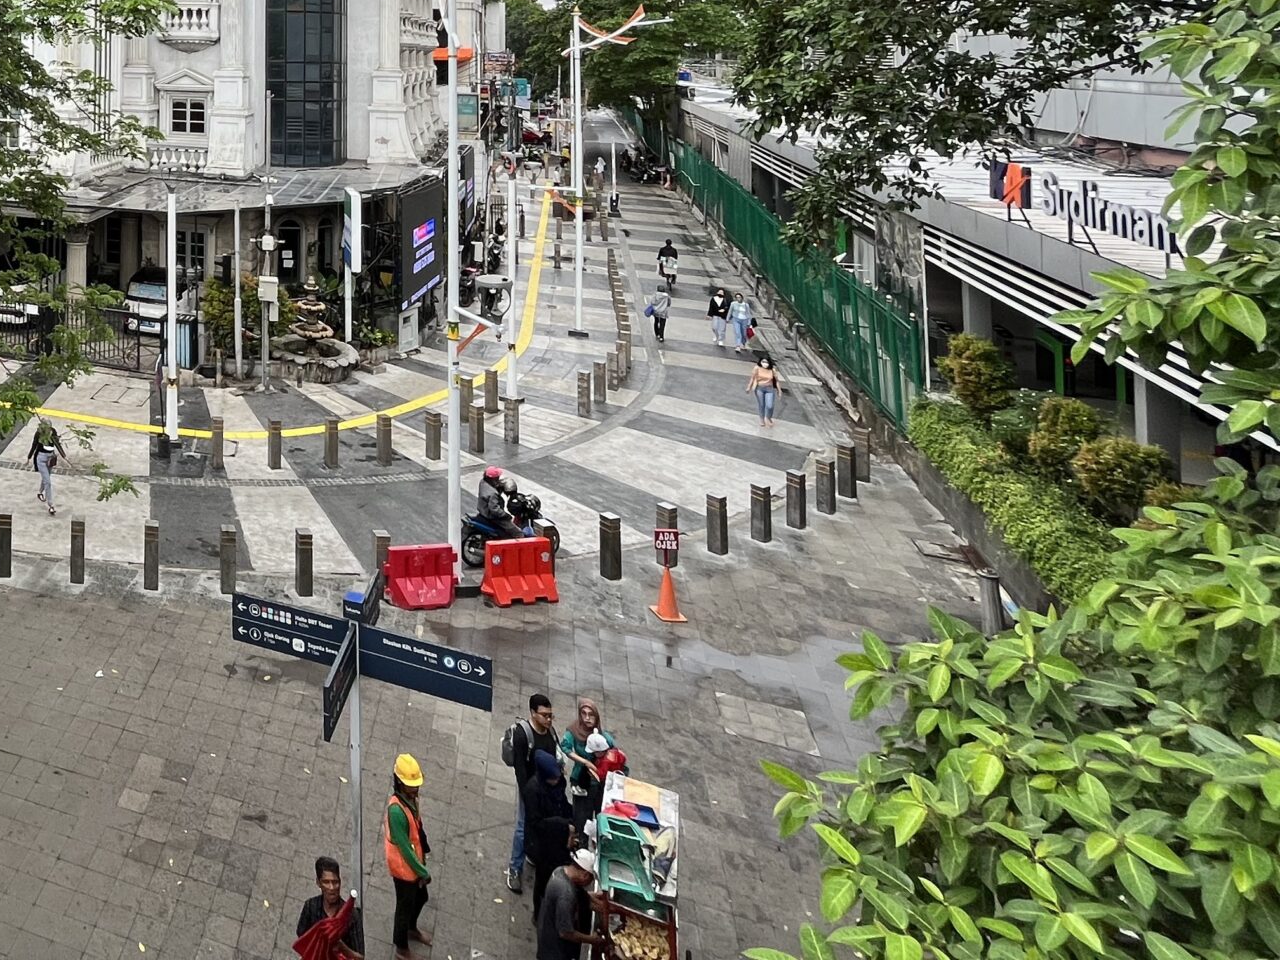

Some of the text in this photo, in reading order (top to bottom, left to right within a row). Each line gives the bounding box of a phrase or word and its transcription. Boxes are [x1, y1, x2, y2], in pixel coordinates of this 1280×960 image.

[1040, 171, 1176, 254] Sudirman
[658, 532, 675, 541] ADA
[655, 540, 677, 550] OJEK
